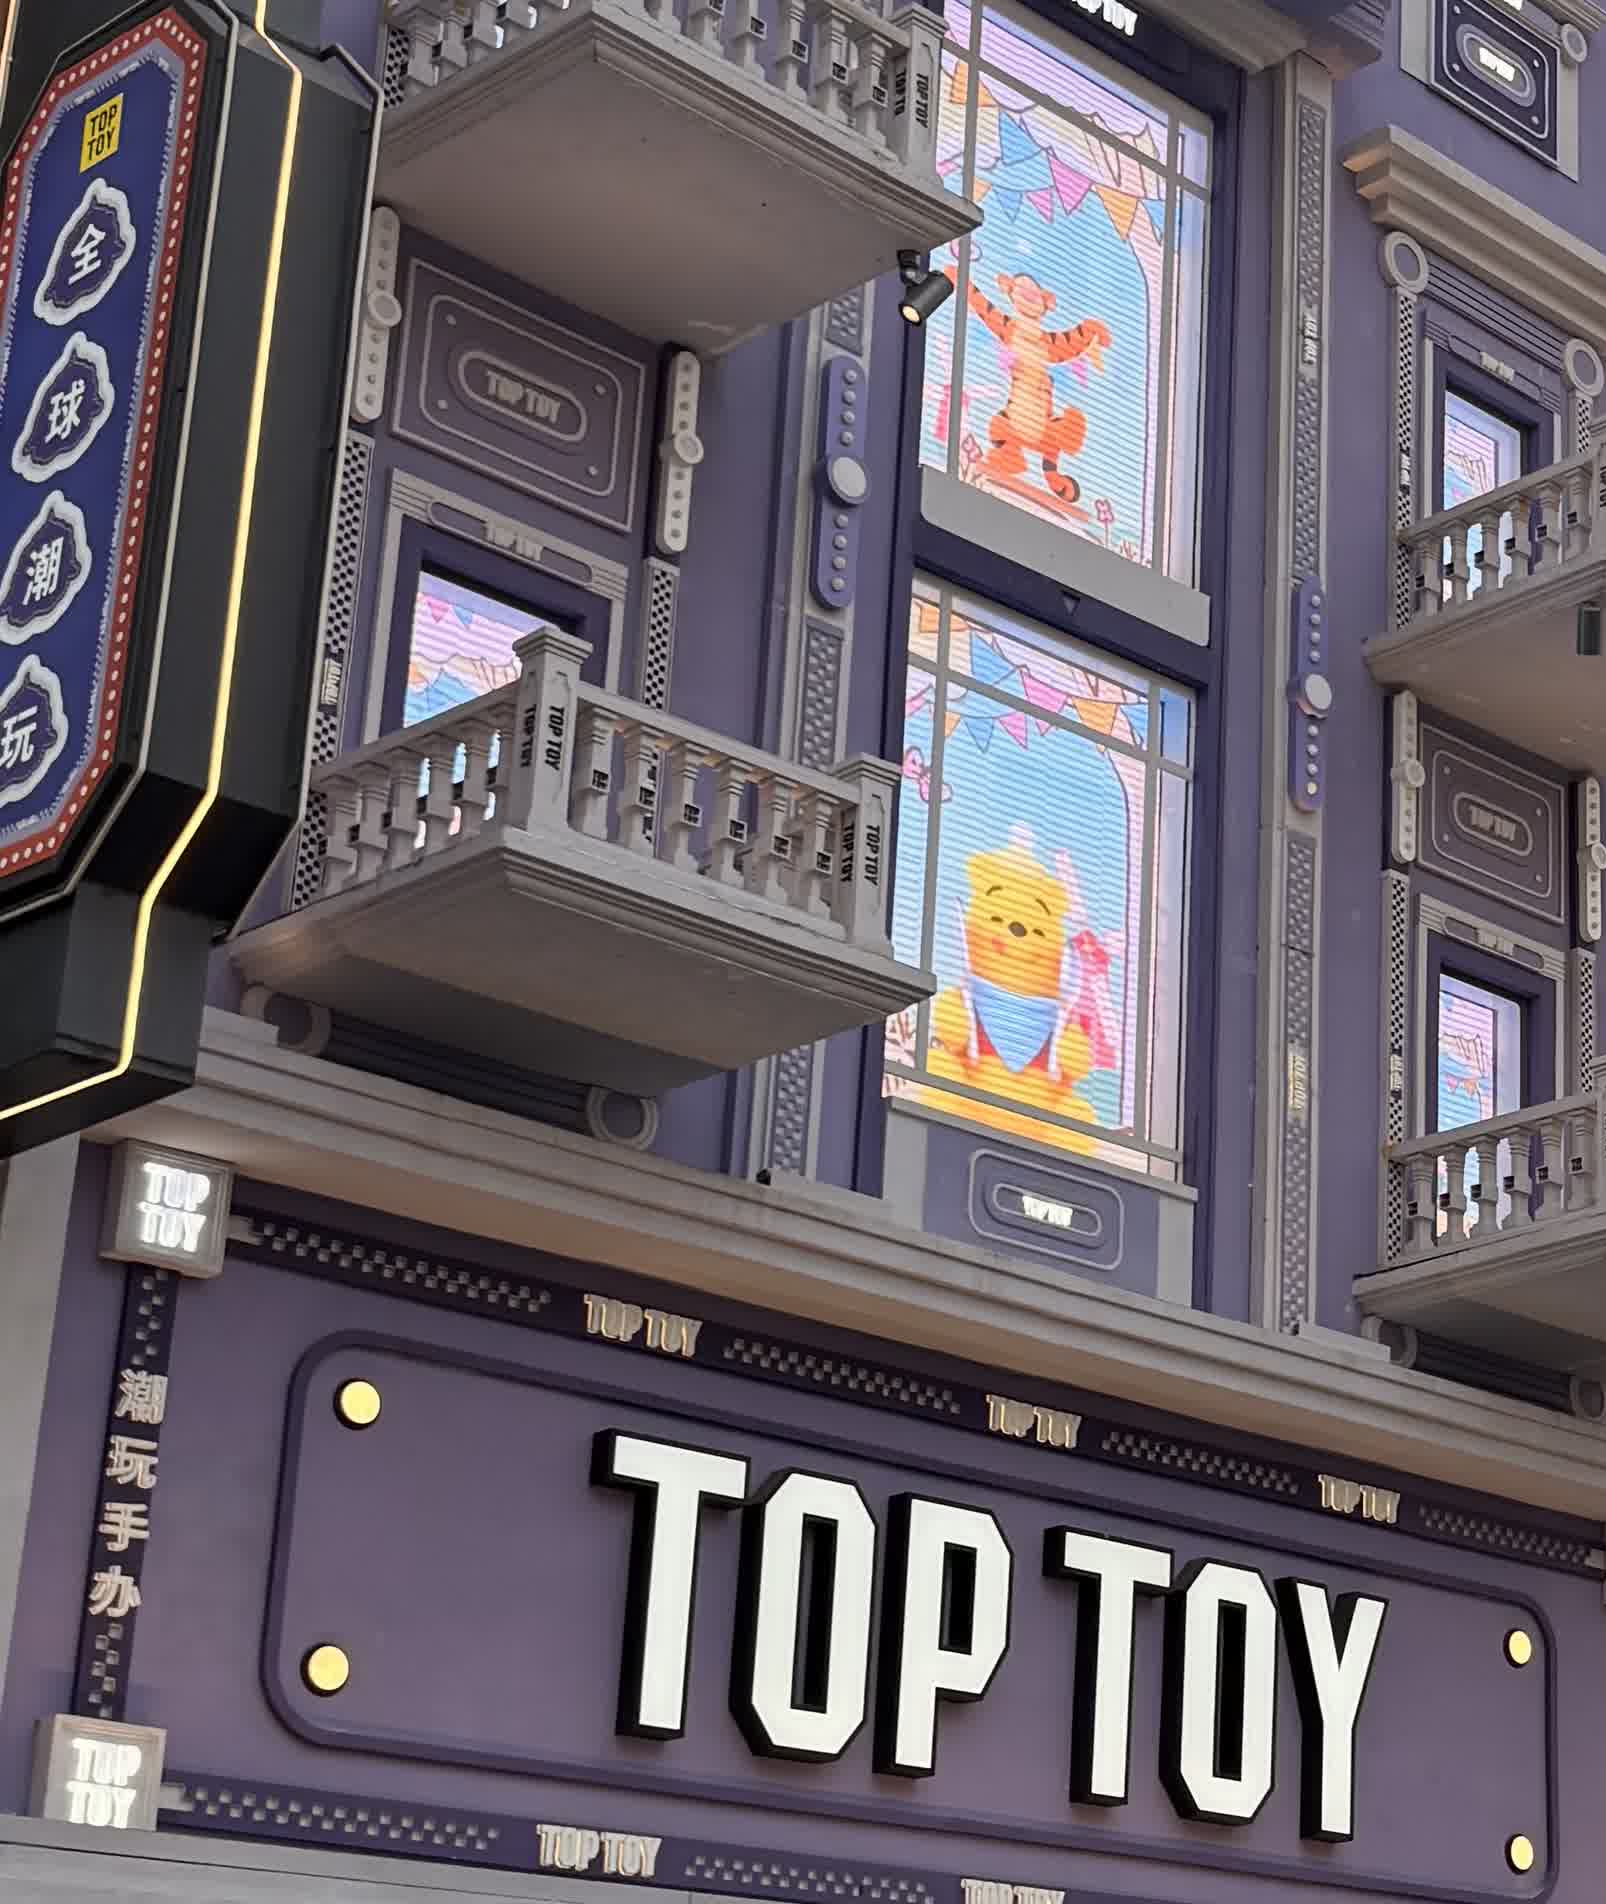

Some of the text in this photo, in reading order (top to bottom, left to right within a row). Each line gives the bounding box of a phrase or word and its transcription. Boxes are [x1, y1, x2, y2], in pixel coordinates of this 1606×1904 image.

[86, 102, 117, 137] TOP
[915, 72, 929, 129] TOP TOY
[84, 128, 115, 159] TOY
[0, 223, 103, 766] 全球潮玩
[545, 706, 563, 771] TOP TOY
[864, 824, 880, 887] TOP TOY
[143, 1162, 210, 1213] TOP
[138, 1201, 206, 1253] TOY
[584, 1294, 702, 1359] TOP TOY
[987, 1394, 1082, 1448] TOP TOY
[90, 1370, 166, 1619] 潮玩手办
[613, 1434, 1387, 1838] TOP TOY
[72, 1737, 141, 1789] TOP
[66, 1778, 137, 1829] TOY
[535, 1823, 662, 1877] TOP TOY
